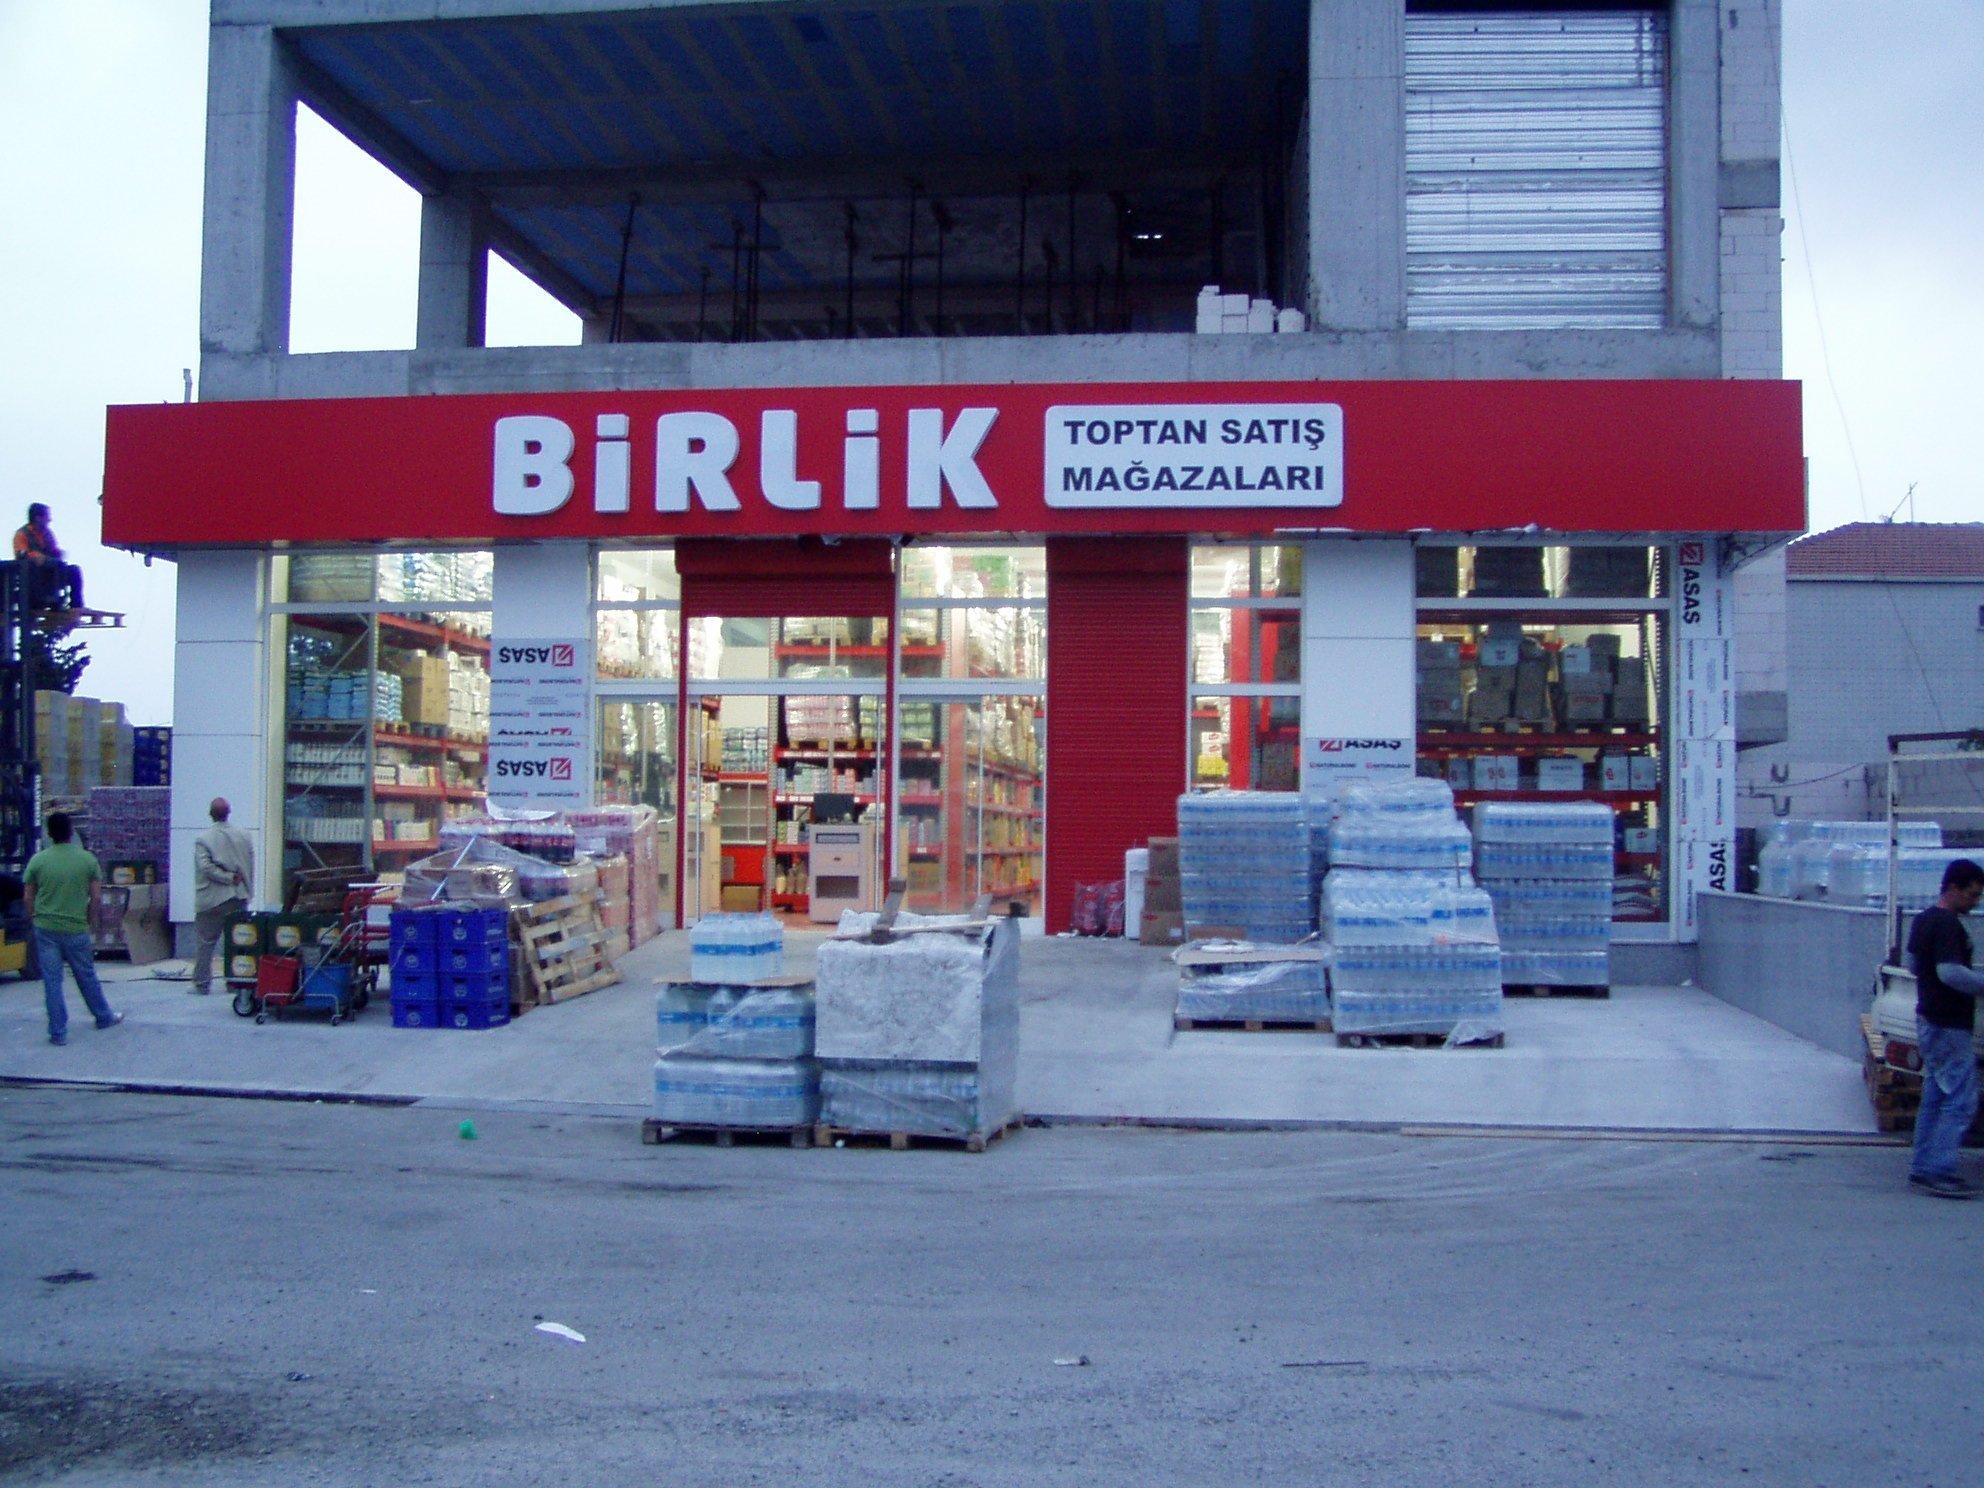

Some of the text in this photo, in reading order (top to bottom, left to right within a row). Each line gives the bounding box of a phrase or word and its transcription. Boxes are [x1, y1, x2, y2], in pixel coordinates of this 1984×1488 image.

[1064, 418, 1325, 451] TOPTAN SATIŞ
[1062, 460, 1324, 492] MAĞAZALARI
